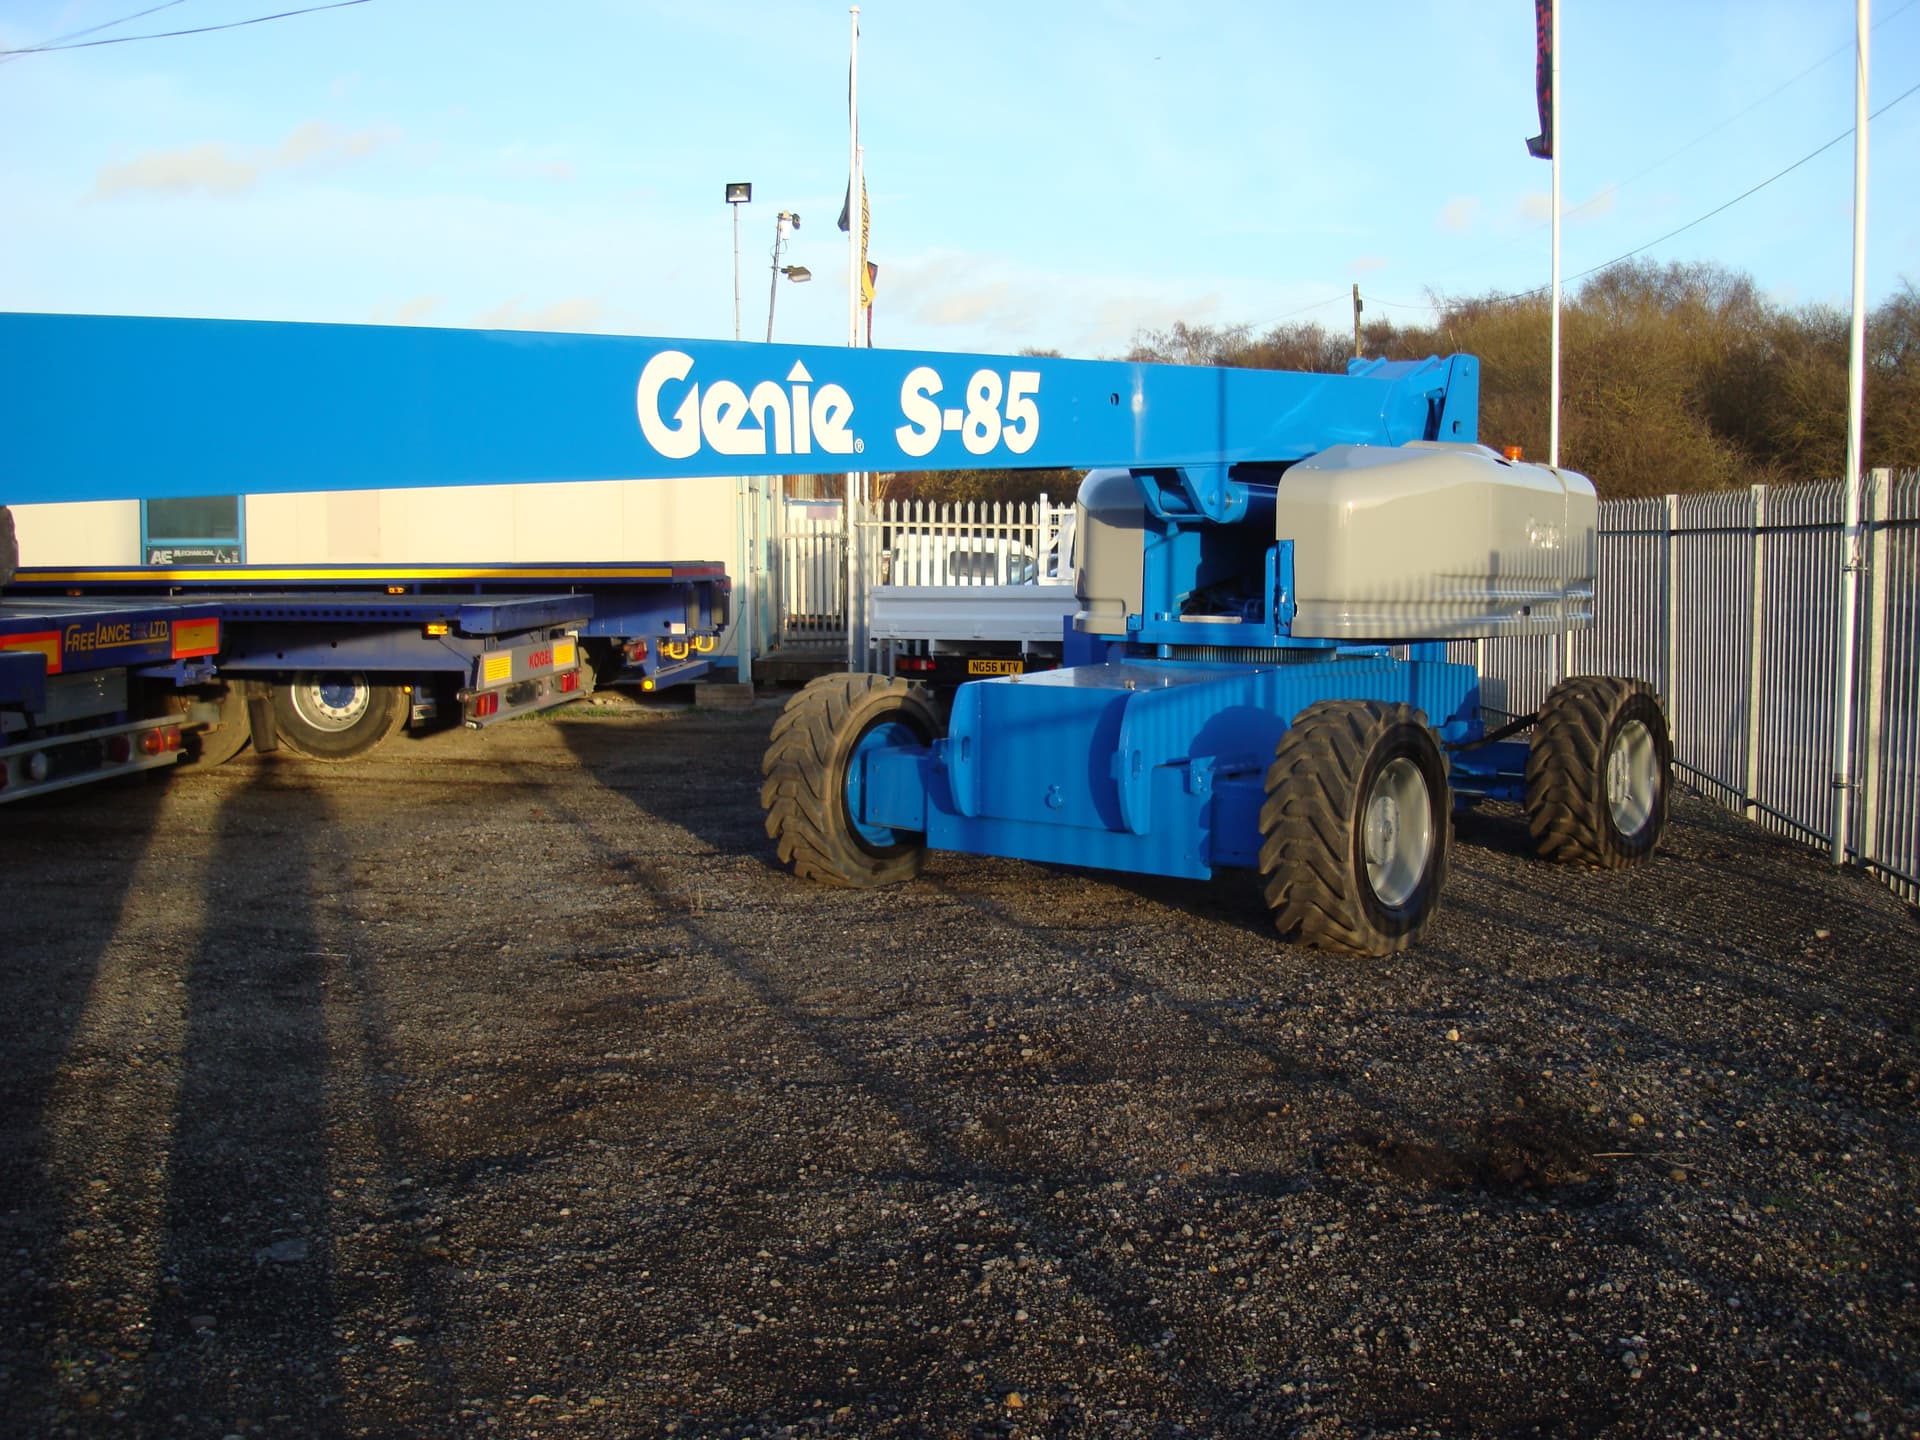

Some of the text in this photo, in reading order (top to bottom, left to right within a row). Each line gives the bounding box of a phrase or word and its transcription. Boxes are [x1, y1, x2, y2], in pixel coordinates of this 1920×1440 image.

[637, 350, 1041, 459] Genie S-85
[972, 661, 1019, 673] NG56 WTV
